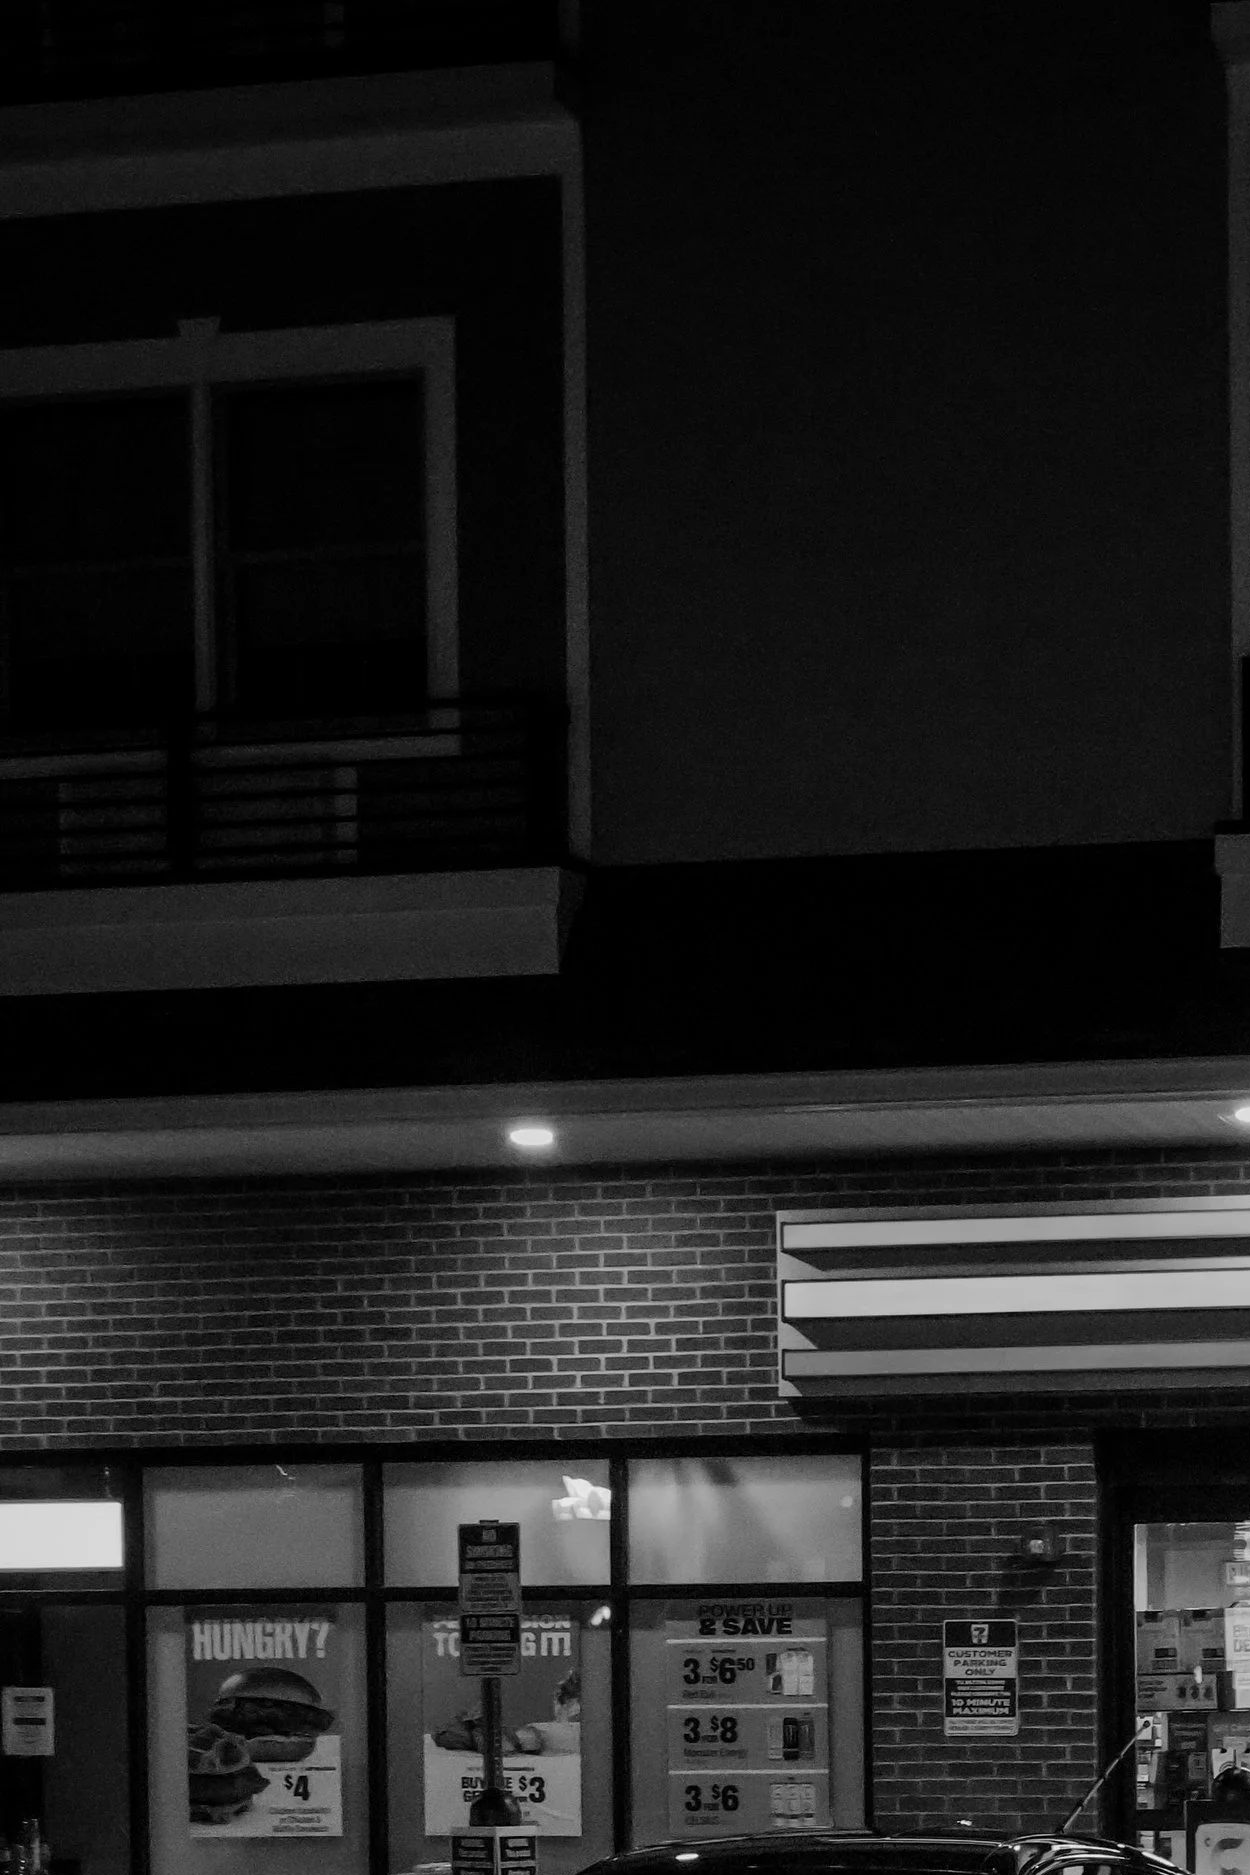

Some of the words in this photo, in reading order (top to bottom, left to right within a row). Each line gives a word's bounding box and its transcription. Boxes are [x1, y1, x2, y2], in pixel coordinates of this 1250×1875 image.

[699, 1604, 763, 1618] POWER
[768, 1603, 792, 1617] UP
[698, 1618, 716, 1635] &
[723, 1617, 793, 1635] SAVE
[192, 1619, 330, 1660] HUNGRY?
[947, 1650, 1013, 1658] CUSTOMER
[953, 1659, 1008, 1667] PARKING
[683, 1658, 700, 1685] 3
[964, 1668, 996, 1676] ONLY
[951, 1698, 965, 1707] 10
[966, 1698, 1011, 1707] MINUTE
[952, 1707, 1010, 1715] MAXIMUM
[683, 1717, 701, 1744] 3
[710, 1715, 739, 1744] $8
[283, 1774, 310, 1801] $4
[518, 1775, 545, 1803] $3
[685, 1785, 702, 1812] 3
[711, 1783, 739, 1812] $6
